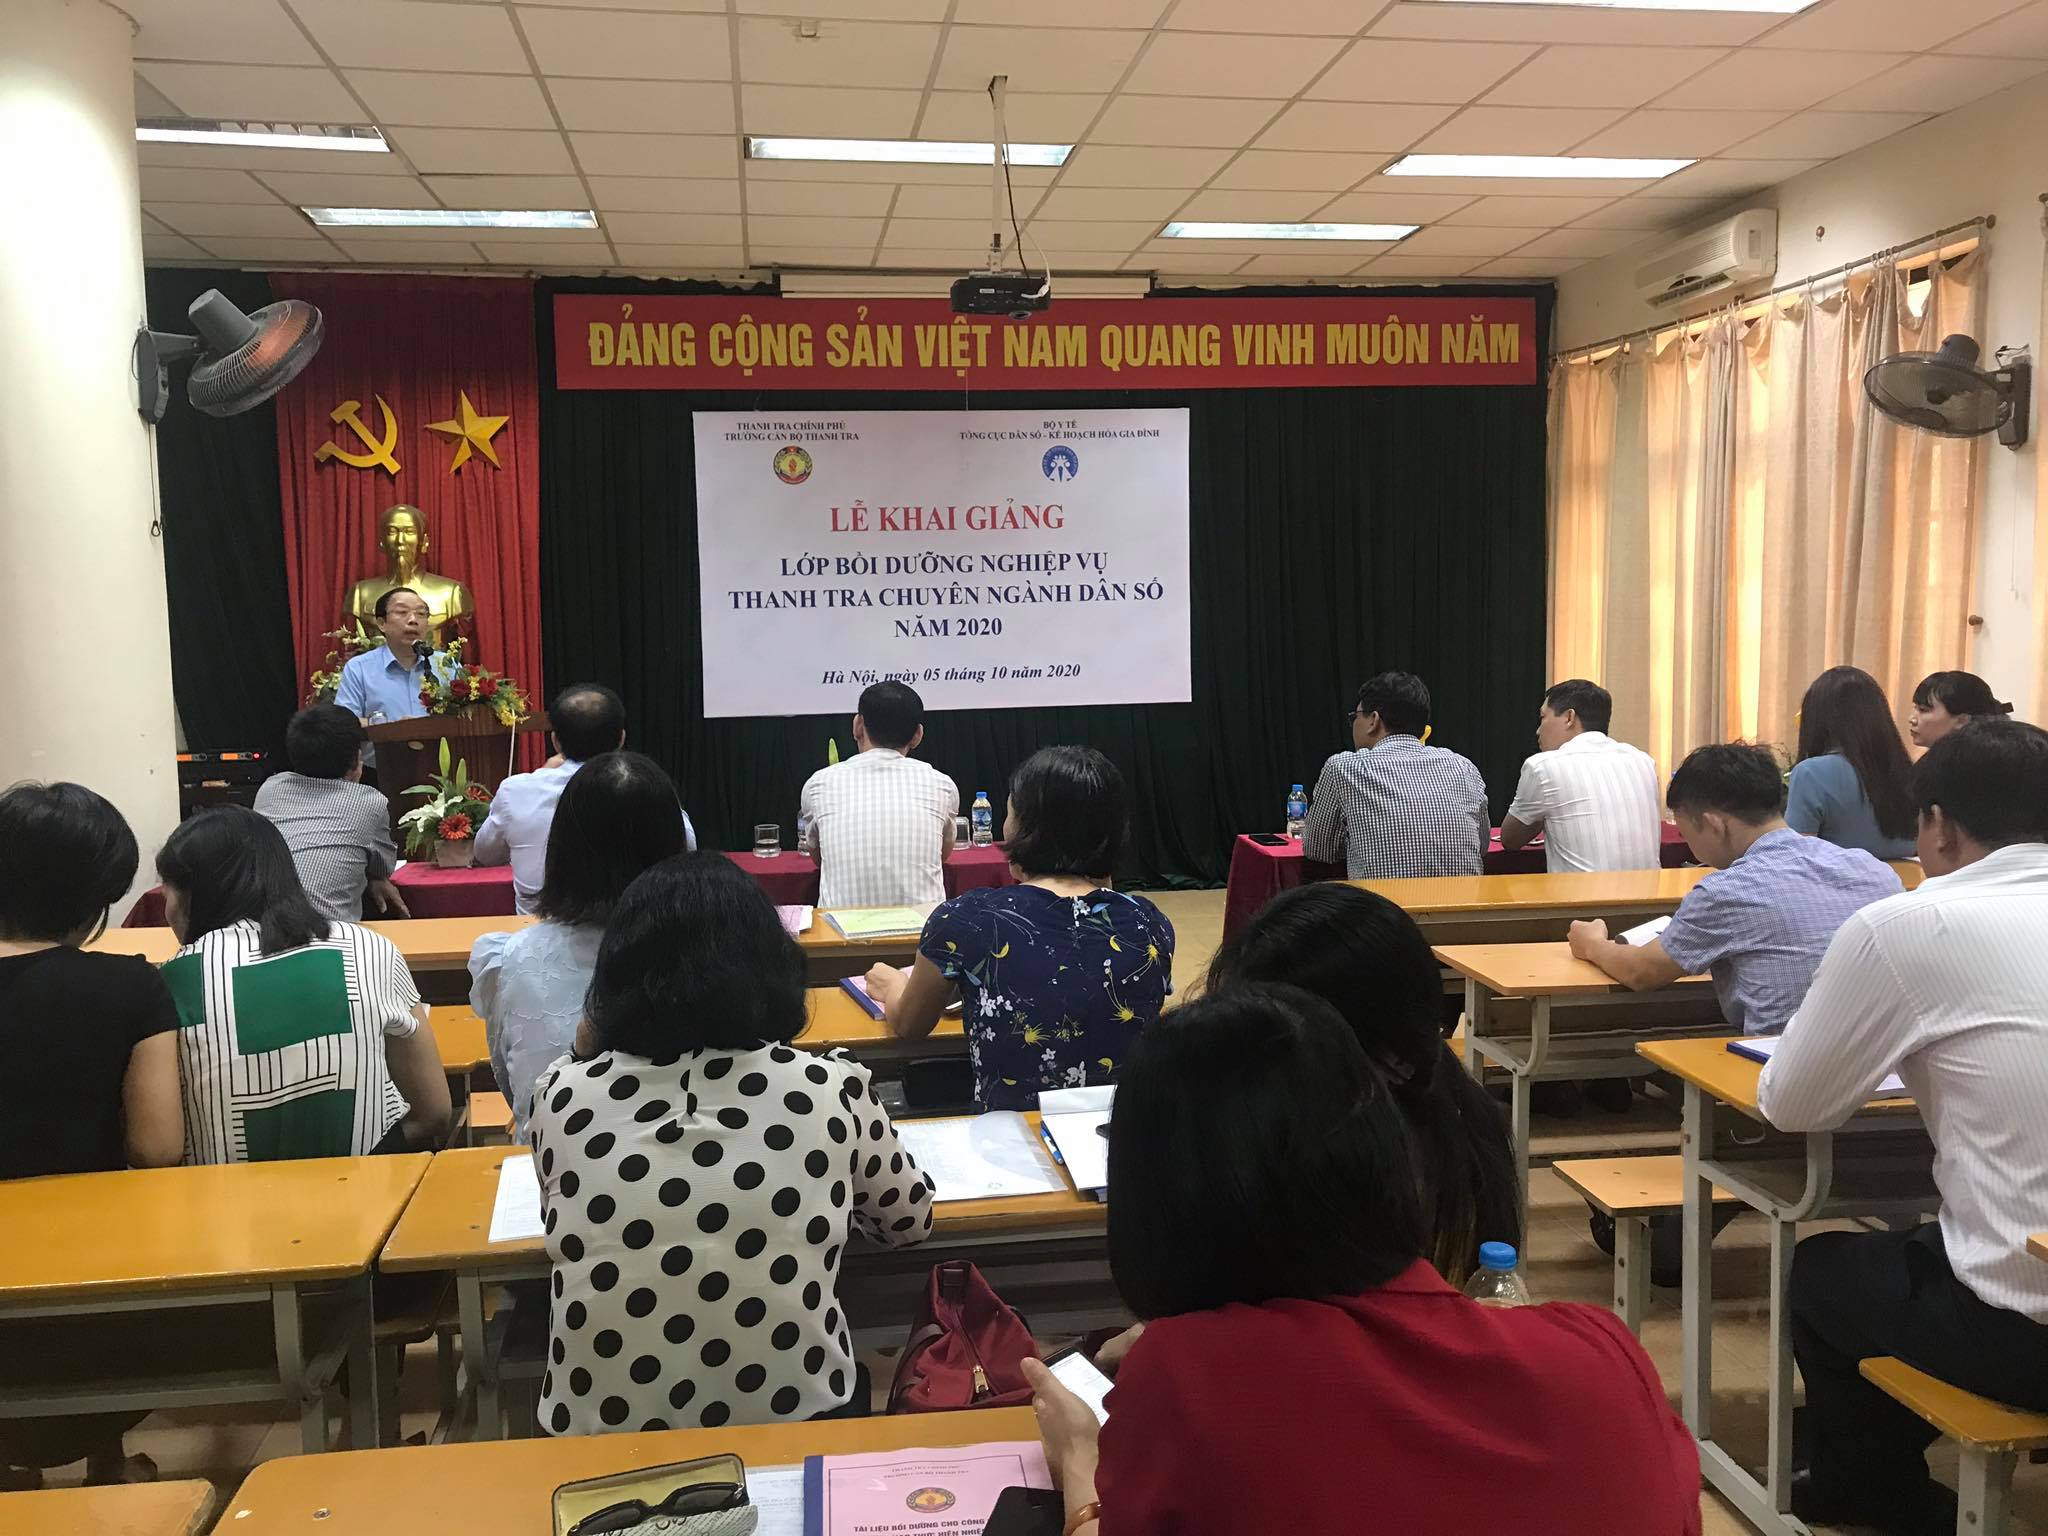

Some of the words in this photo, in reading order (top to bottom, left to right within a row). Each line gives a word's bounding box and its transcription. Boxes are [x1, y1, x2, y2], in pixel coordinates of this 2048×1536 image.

[588, 303, 696, 366] ĐẢNG
[709, 313, 813, 377] CỘNG
[826, 306, 902, 368] SẢN
[914, 315, 992, 377] VIỆT
[1004, 324, 1087, 367] NAM
[1100, 324, 1221, 372] QUANG
[1232, 323, 1314, 366] VINH
[1326, 314, 1430, 365] MUÔN
[1441, 313, 1520, 364] NĂM
[737, 422, 770, 431] THANH
[773, 422, 792, 431] TRA
[1057, 421, 1064, 429] Y
[1119, 430, 1136, 439] GIA
[804, 432, 838, 441] THANH
[840, 432, 860, 441] TRA
[830, 500, 870, 533] LỄ
[878, 505, 958, 532] KHAI
[965, 497, 1065, 530] GIẢNG
[780, 552, 830, 577] LỚP
[835, 551, 879, 576] BỒI
[885, 551, 974, 575] DƯỠNG
[980, 550, 1072, 576] NGHIỆP
[1075, 552, 1108, 575] VỤ
[728, 590, 817, 610] THANH
[823, 589, 874, 609] TRA
[878, 581, 980, 607] CHUYÊN
[987, 579, 1072, 604] NGÀNH
[1078, 578, 1127, 602] DÂN
[1133, 577, 1164, 601] SỐ
[894, 614, 950, 638] NĂM
[956, 617, 1003, 636] 2020
[822, 670, 845, 685] Hà
[923, 667, 941, 681] 05
[944, 667, 986, 683] tháng
[990, 666, 1008, 680] 10
[1011, 667, 1042, 679] năm
[1046, 663, 1081, 678] 2020
[940, 1519, 959, 1527] CHO
[961, 1517, 985, 1525] CÔNG
